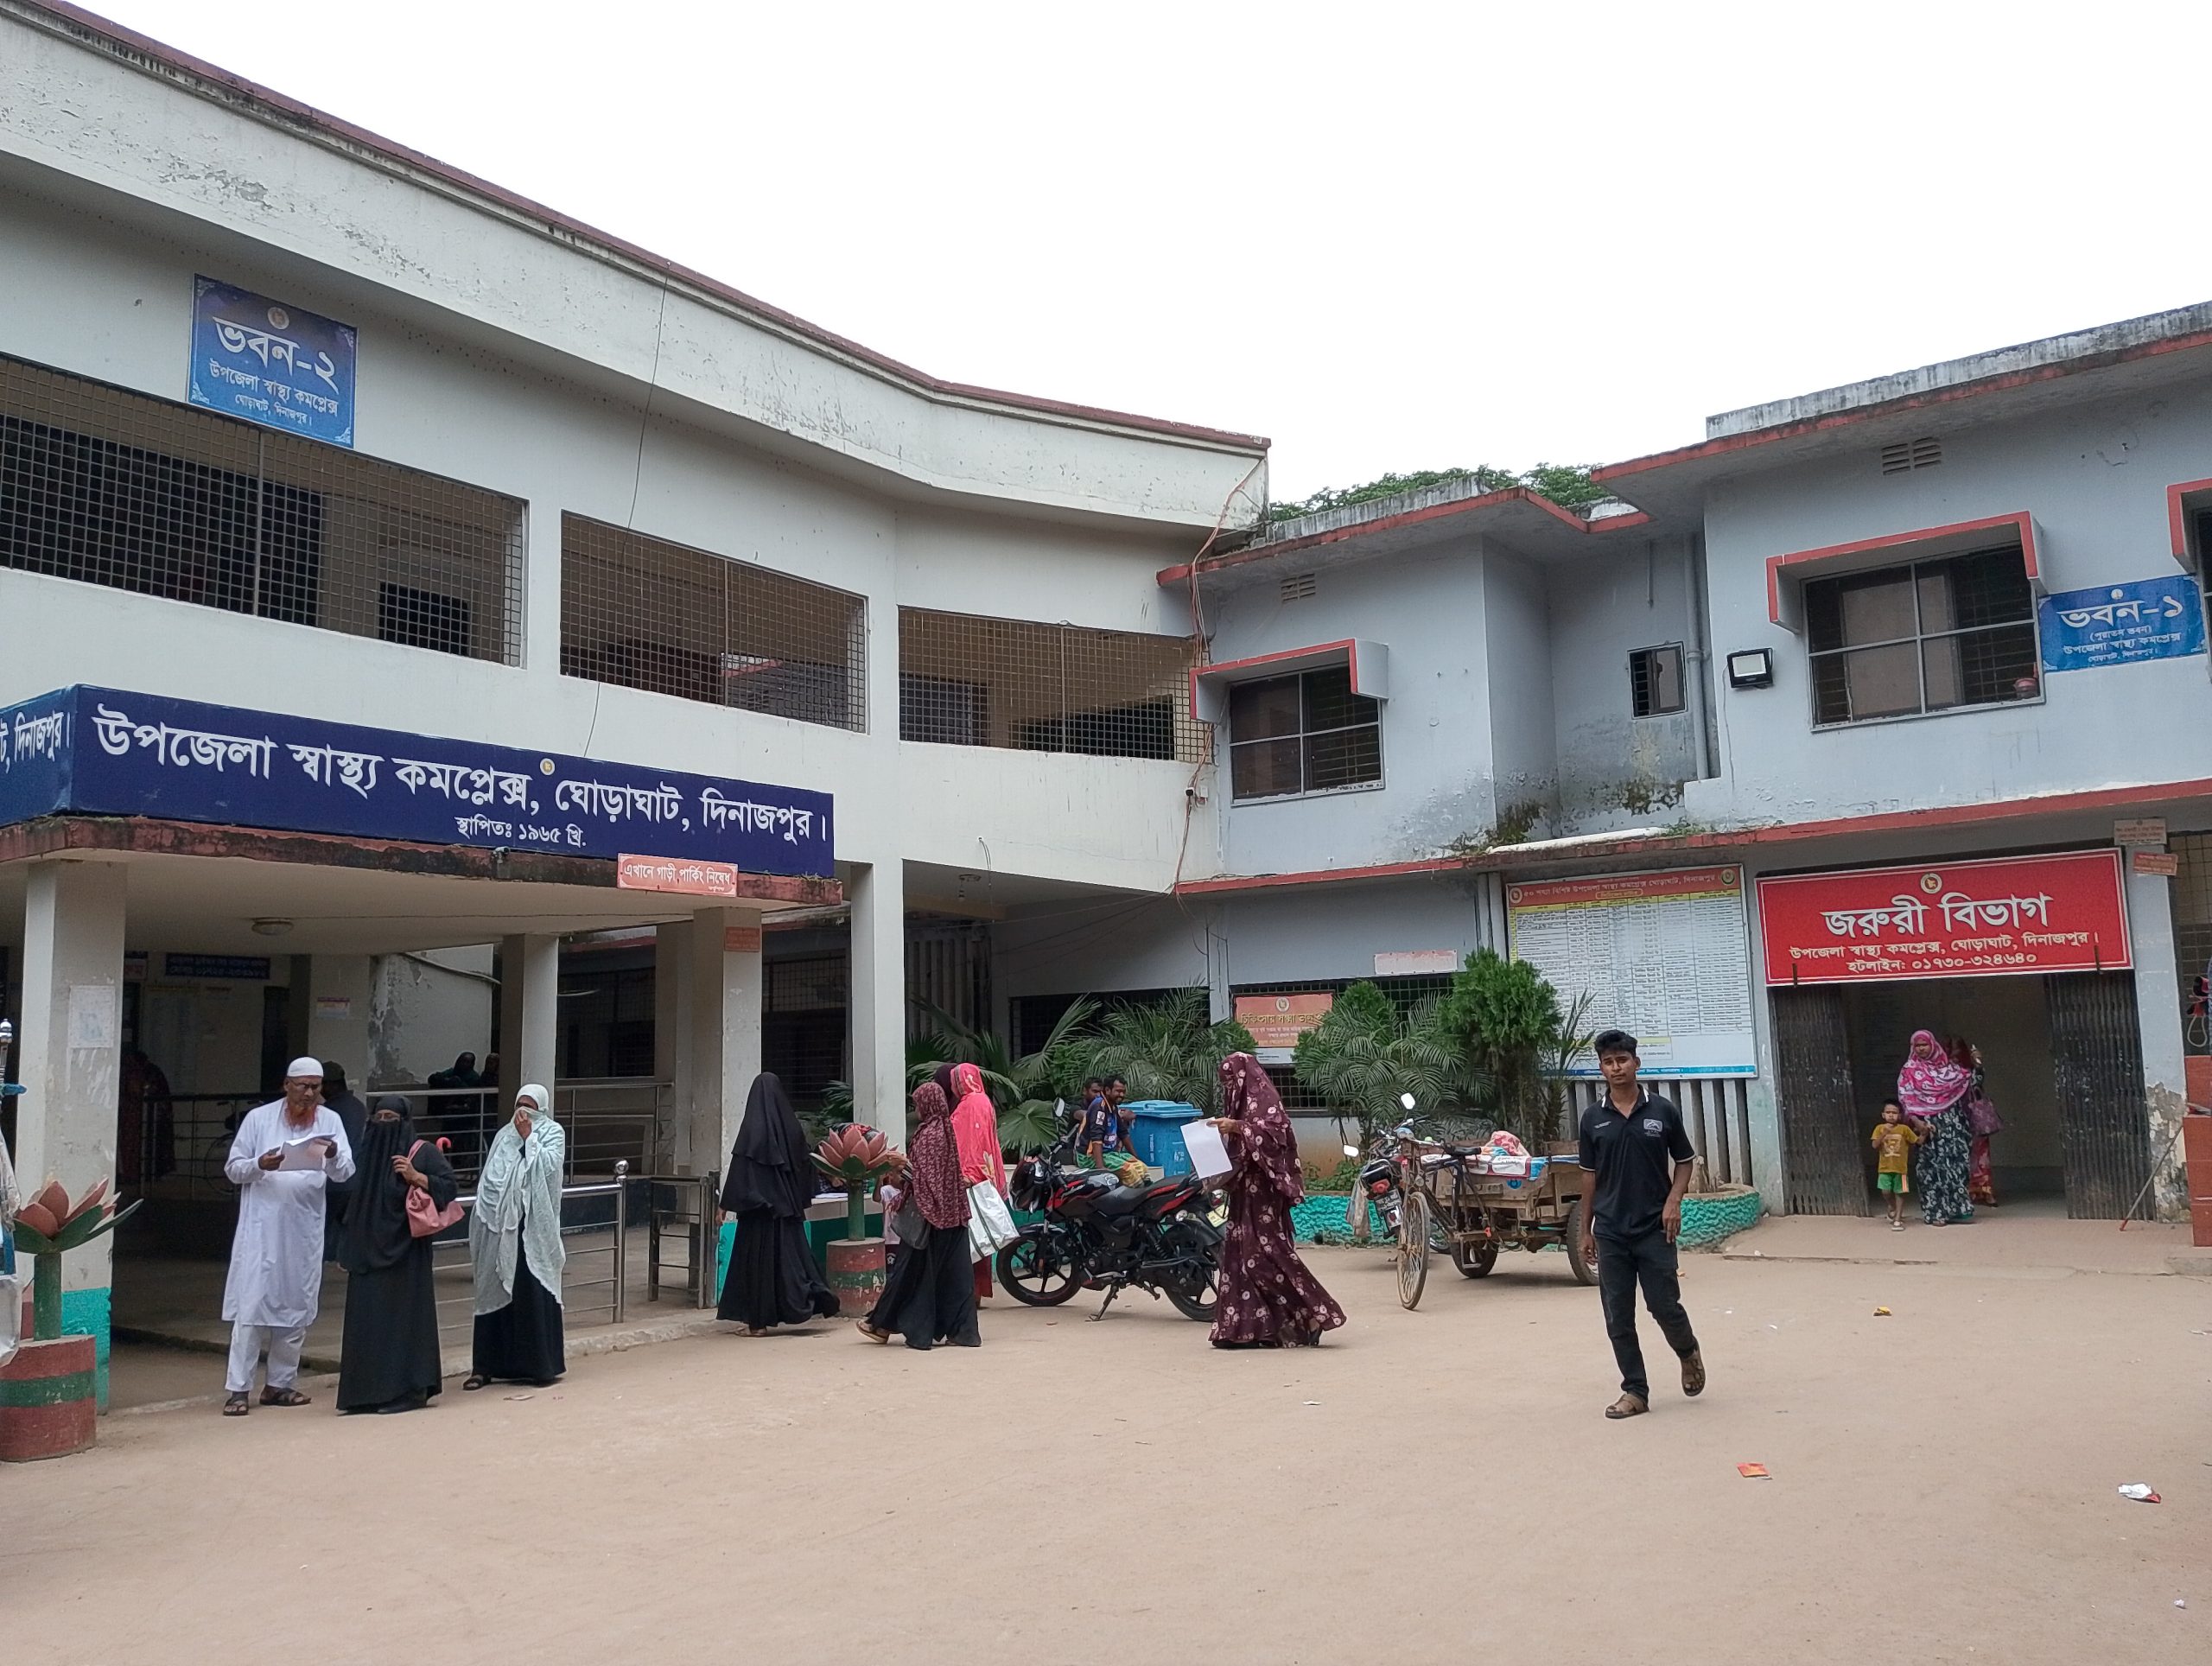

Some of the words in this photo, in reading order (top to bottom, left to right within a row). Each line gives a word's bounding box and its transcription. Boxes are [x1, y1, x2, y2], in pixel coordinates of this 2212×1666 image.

[213, 316, 340, 395] ভবন-২
[209, 358, 259, 392] উপজেলা
[263, 378, 291, 404] স্বাস্থ্য
[295, 388, 339, 416] কমপ্লেক্স
[2056, 595, 2183, 629] ভবন-১
[92, 703, 278, 779] উপজেলা
[286, 744, 385, 799] স্বাস্থ্য
[394, 758, 540, 817] কমপ্লেক্স,
[556, 777, 690, 832] ঘোড়াঘাট,
[518, 823, 560, 844] ১৯৬৫
[624, 864, 654, 879] এখানে
[657, 862, 677, 883] গাড়ী
[679, 865, 704, 884] পার্কিং
[706, 867, 731, 885] নিষেধ
[1821, 894, 1930, 938] জরুরী
[1938, 892, 2053, 932] বিভাগ
[1789, 945, 1846, 961] উপজেলা
[1847, 944, 1882, 958] স্বাস্থ্য
[1885, 940, 1946, 956] কমপ্লেক্স,
[1950, 933, 2018, 951] ঘোড়াঘাট,
[1910, 952, 2037, 970] ০১৭৩০-৩২৪৬৪০
